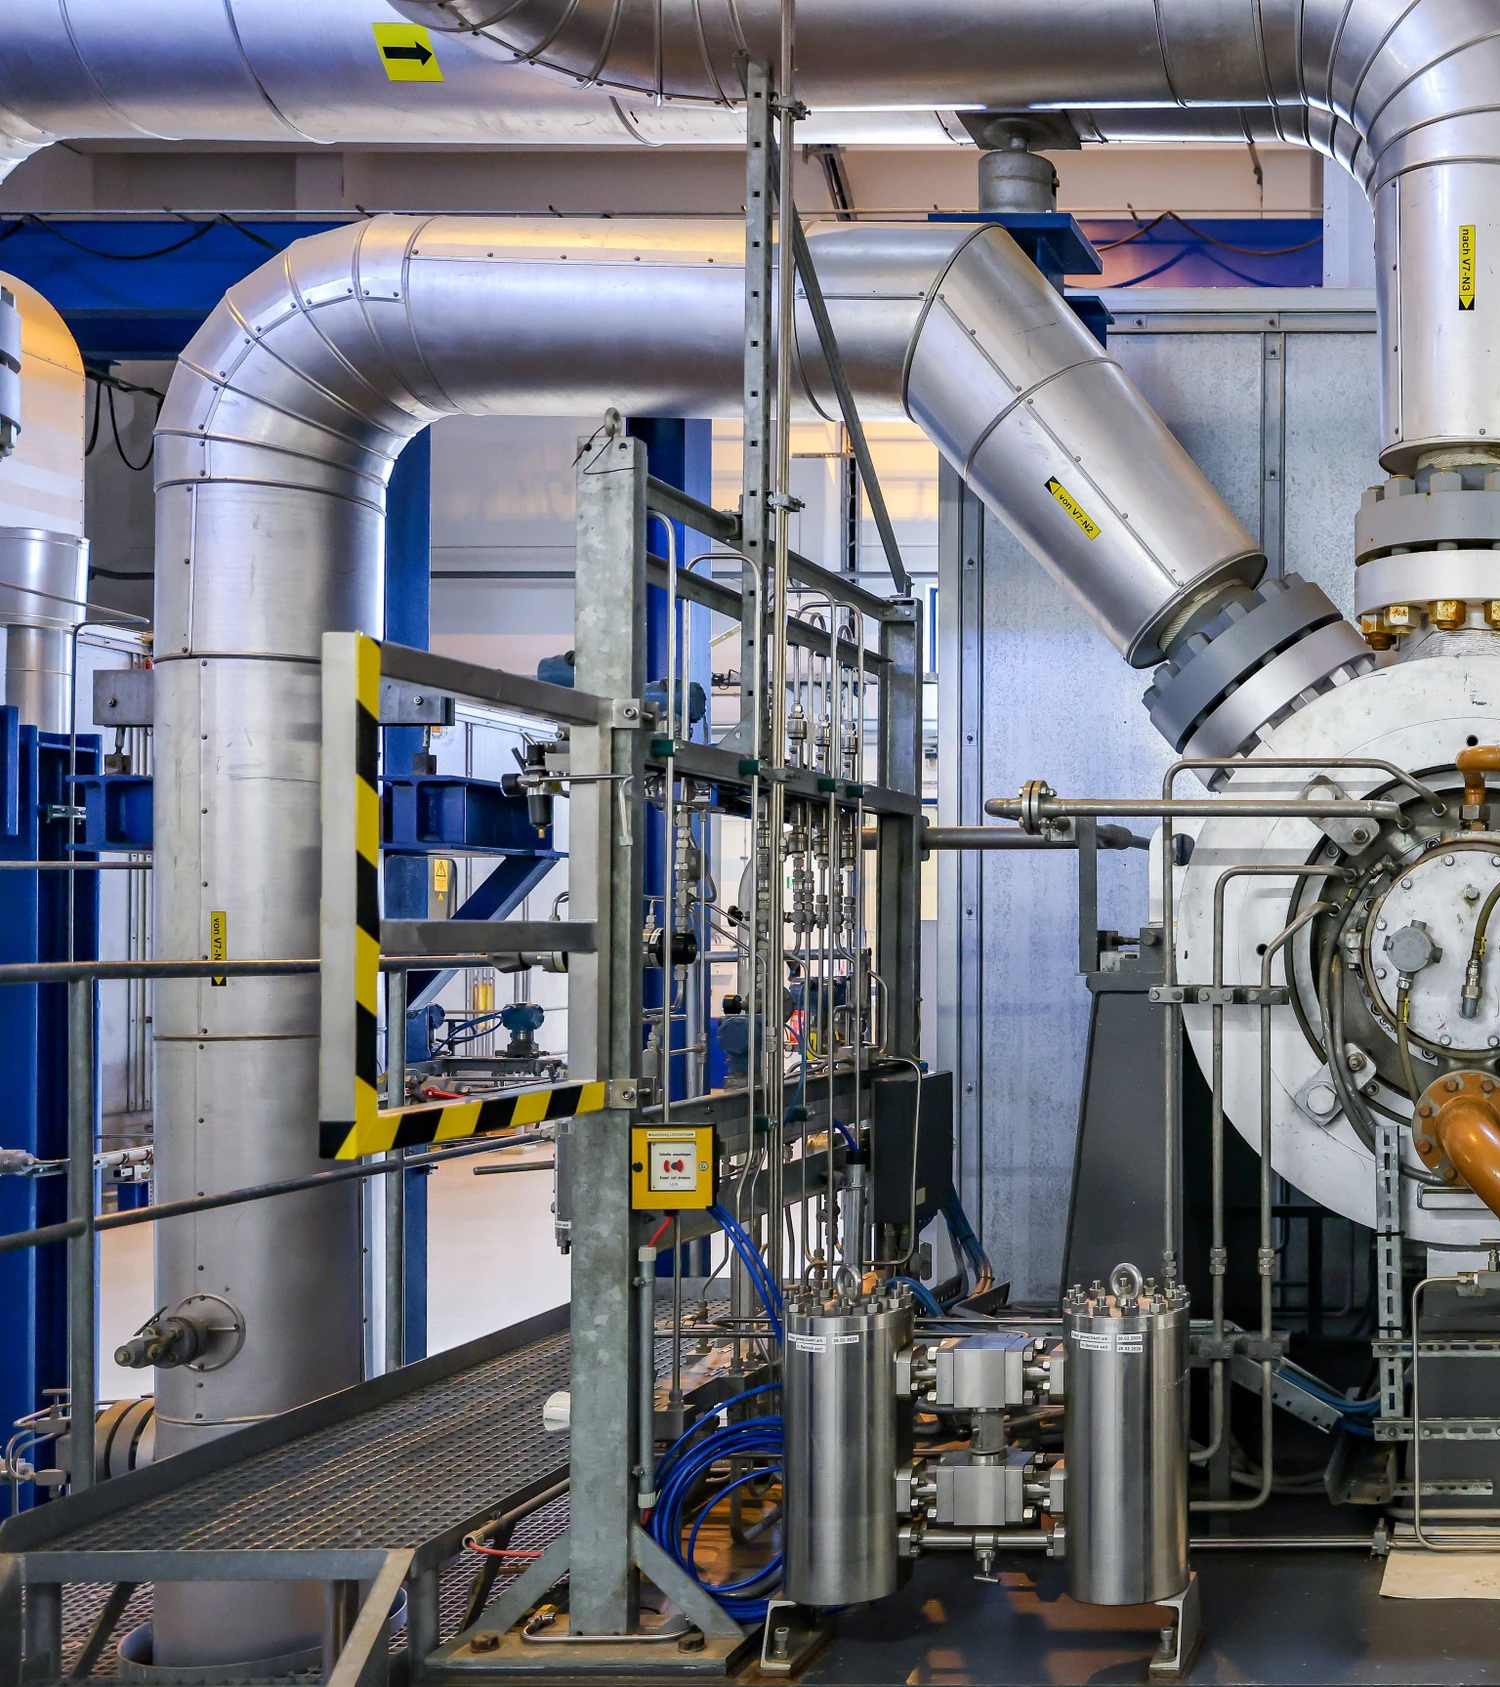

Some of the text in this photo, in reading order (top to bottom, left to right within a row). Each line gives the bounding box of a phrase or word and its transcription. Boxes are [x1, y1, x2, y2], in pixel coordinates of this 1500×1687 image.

[1462, 229, 1471, 291] nach V7-N3
[1059, 494, 1094, 534] von V7-N2
